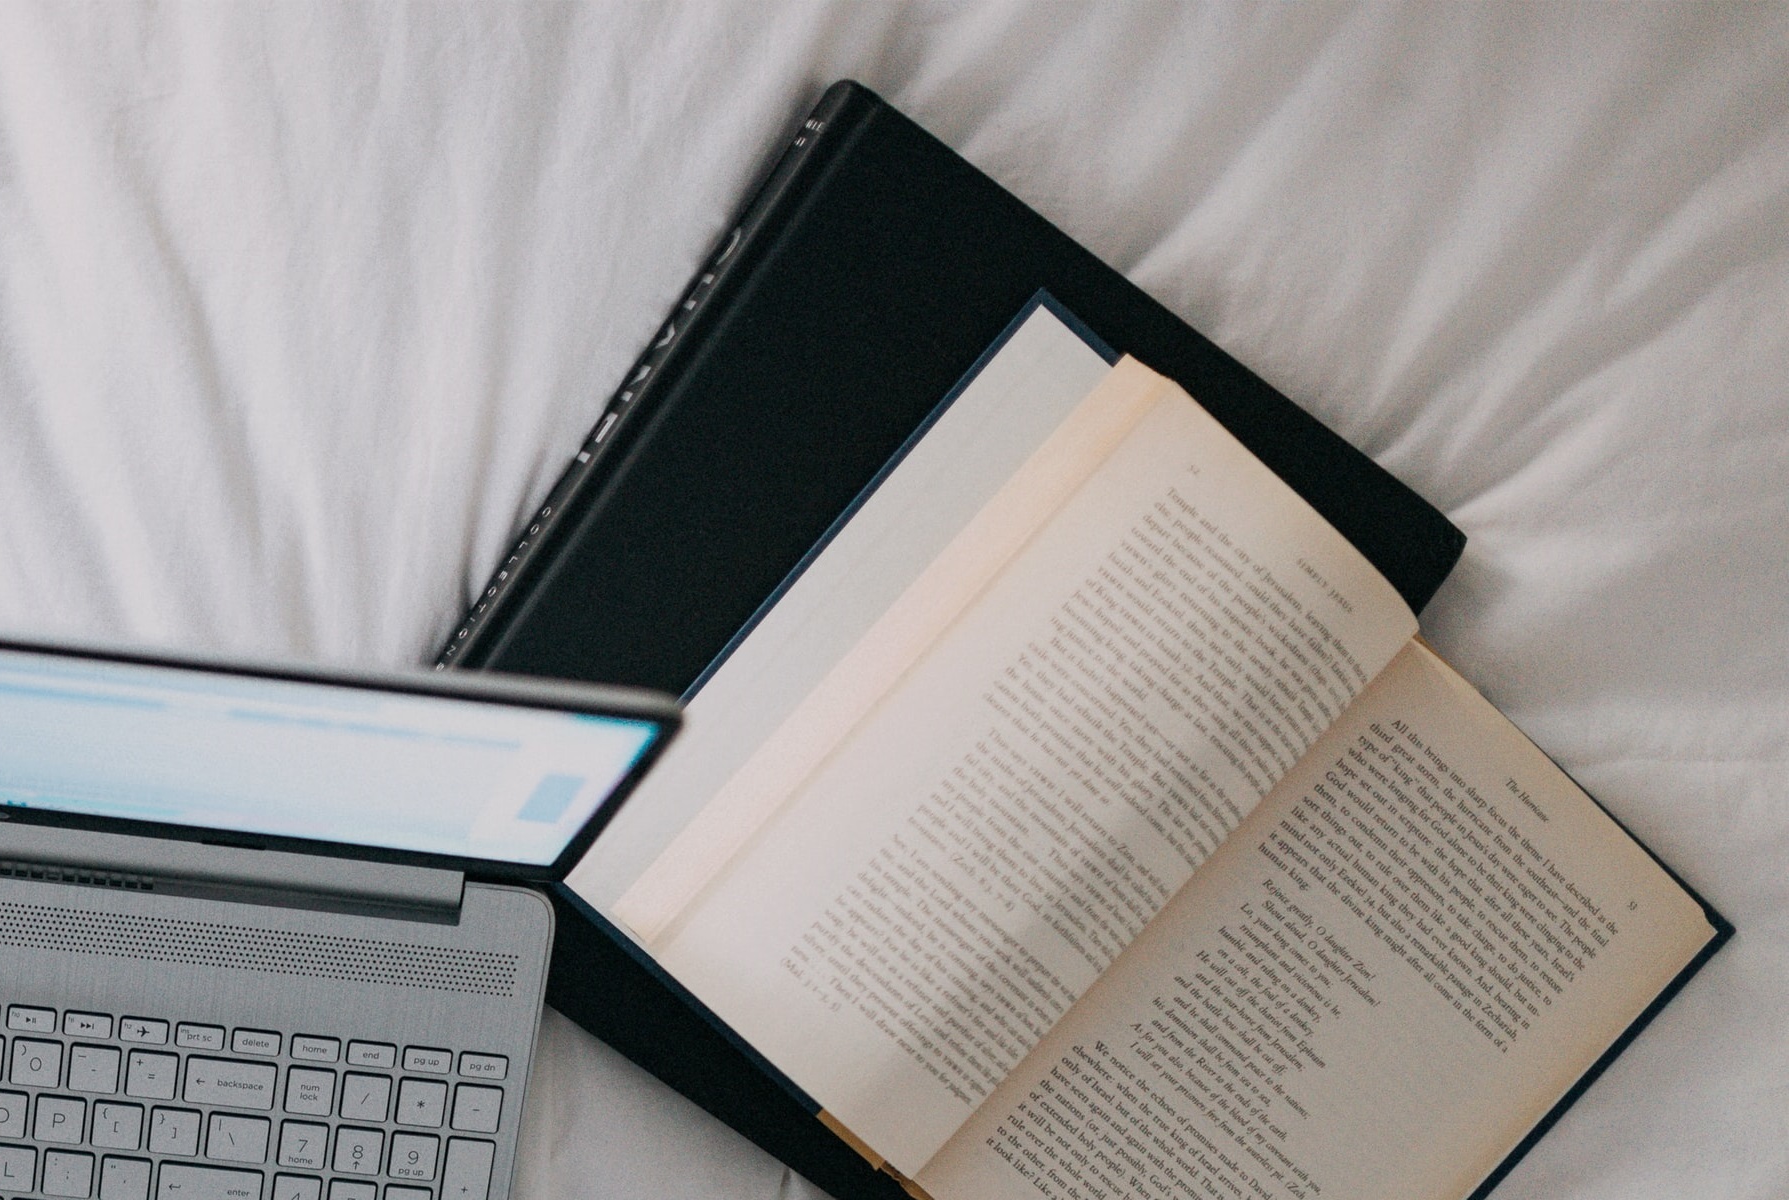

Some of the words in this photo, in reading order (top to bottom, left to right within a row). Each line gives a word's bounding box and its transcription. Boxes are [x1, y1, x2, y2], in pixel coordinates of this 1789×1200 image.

[1504, 776, 1522, 796] The
[1516, 789, 1550, 824] Hurricane
[1256, 841, 1289, 872] human
[1260, 878, 1290, 905] Rejoice
[1285, 904, 1314, 929] greatly,
[1315, 925, 1327, 937] O
[1323, 934, 1354, 963] daughter
[1351, 959, 1377, 982] Zion!
[1260, 899, 1286, 923] Shout
[1283, 921, 1307, 943] aloud,
[1306, 939, 1318, 951] O
[1314, 949, 1345, 977] daughter
[1340, 973, 1382, 1008] Jerusalem!
[186, 1031, 201, 1041] prt
[241, 1038, 270, 1048] delete
[302, 1044, 328, 1055] home
[362, 1052, 380, 1060] end
[413, 1057, 426, 1066] pg
[427, 1059, 440, 1067] up
[469, 1063, 482, 1072] pg
[483, 1063, 496, 1072] dn
[216, 1078, 264, 1091] backspace
[300, 1083, 321, 1092] num
[299, 1092, 318, 1101] lock
[287, 1155, 314, 1165] home
[984, 1137, 995, 1147] it
[992, 1141, 1013, 1164] look
[1011, 1158, 1036, 1180] like?
[1031, 1176, 1052, 1197] Like
[226, 1189, 250, 1197] enter
